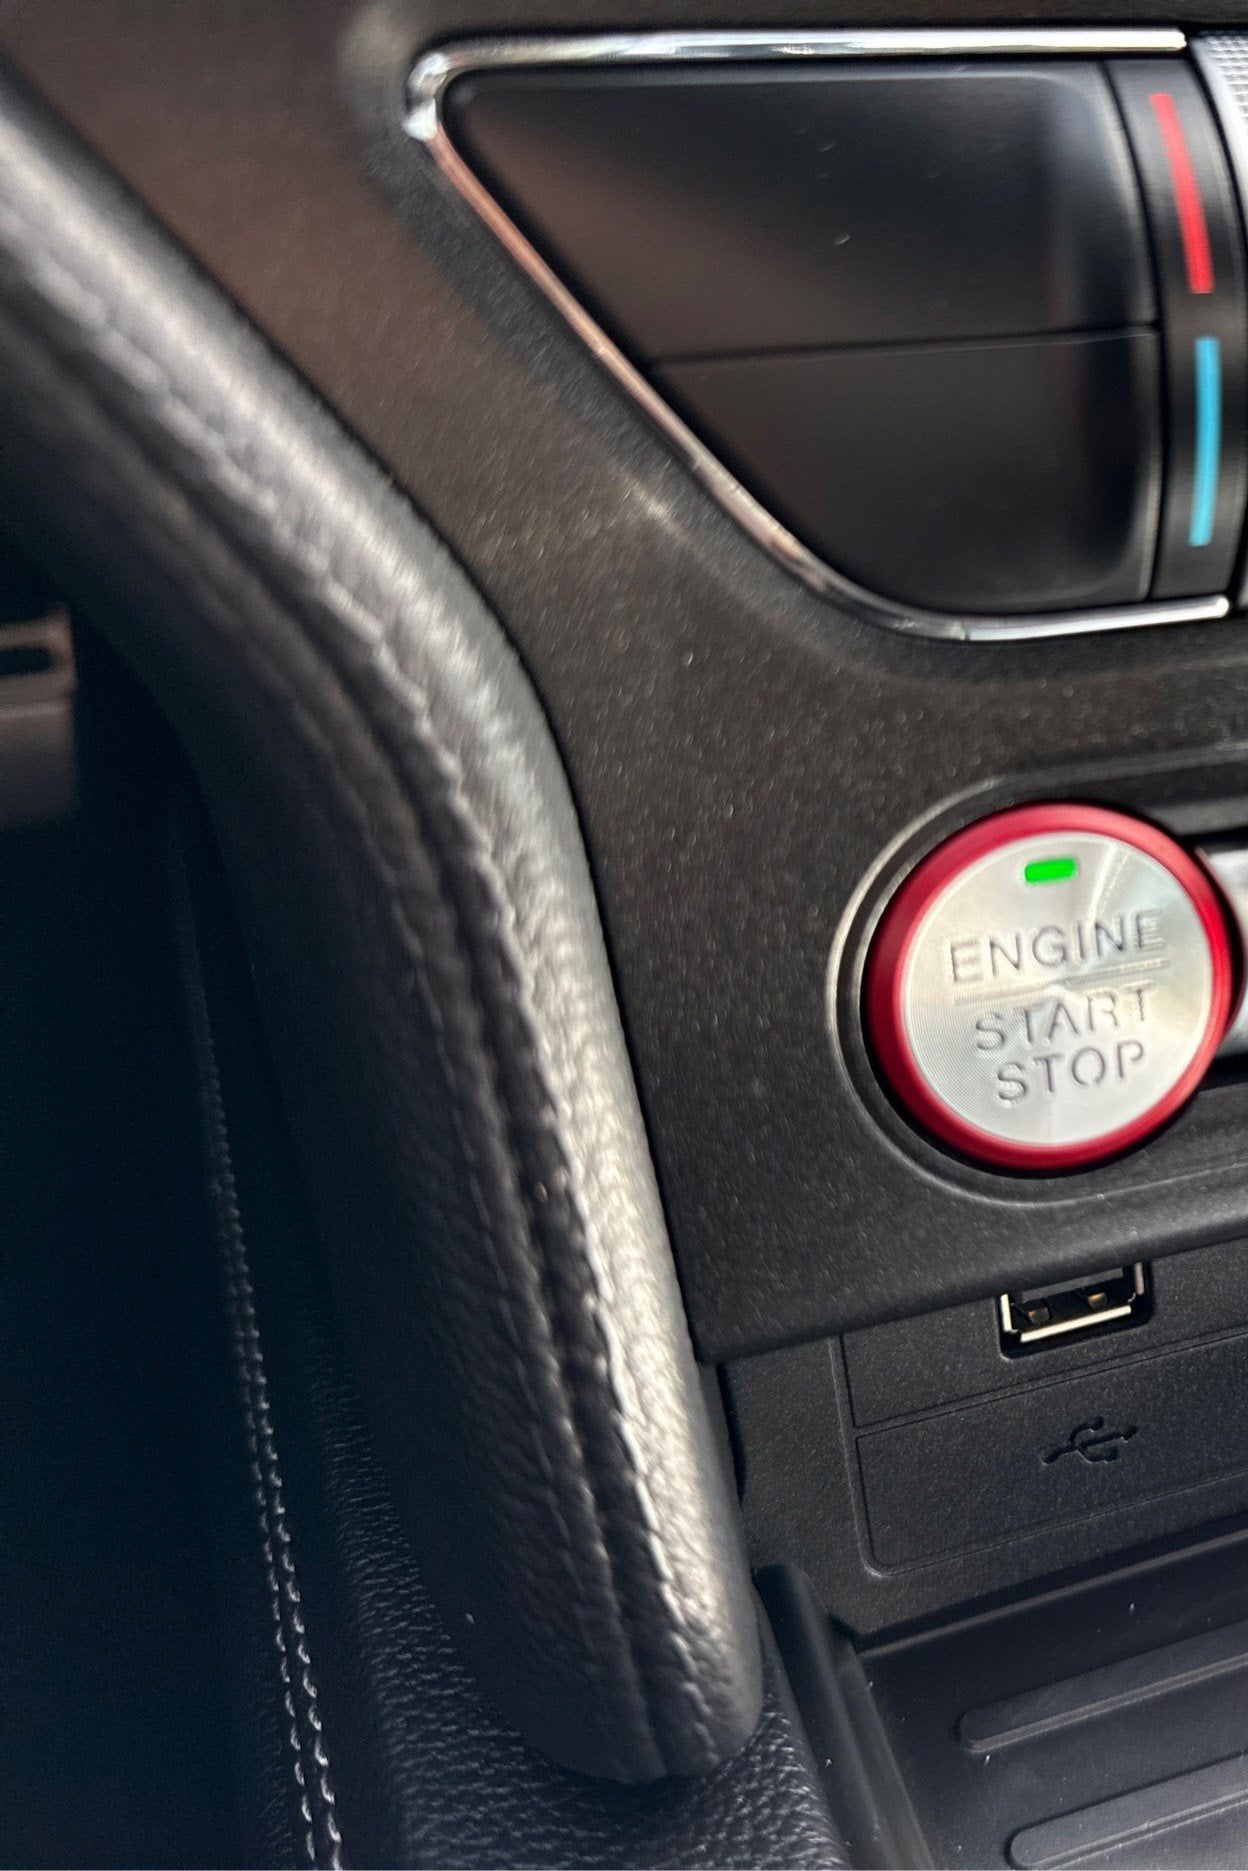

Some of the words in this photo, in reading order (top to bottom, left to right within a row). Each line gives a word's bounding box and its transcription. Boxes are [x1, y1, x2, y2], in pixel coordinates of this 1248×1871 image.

[947, 908, 1167, 985] ENGINE
[974, 980, 1156, 1053] START
[996, 1039, 1146, 1103] STOP
